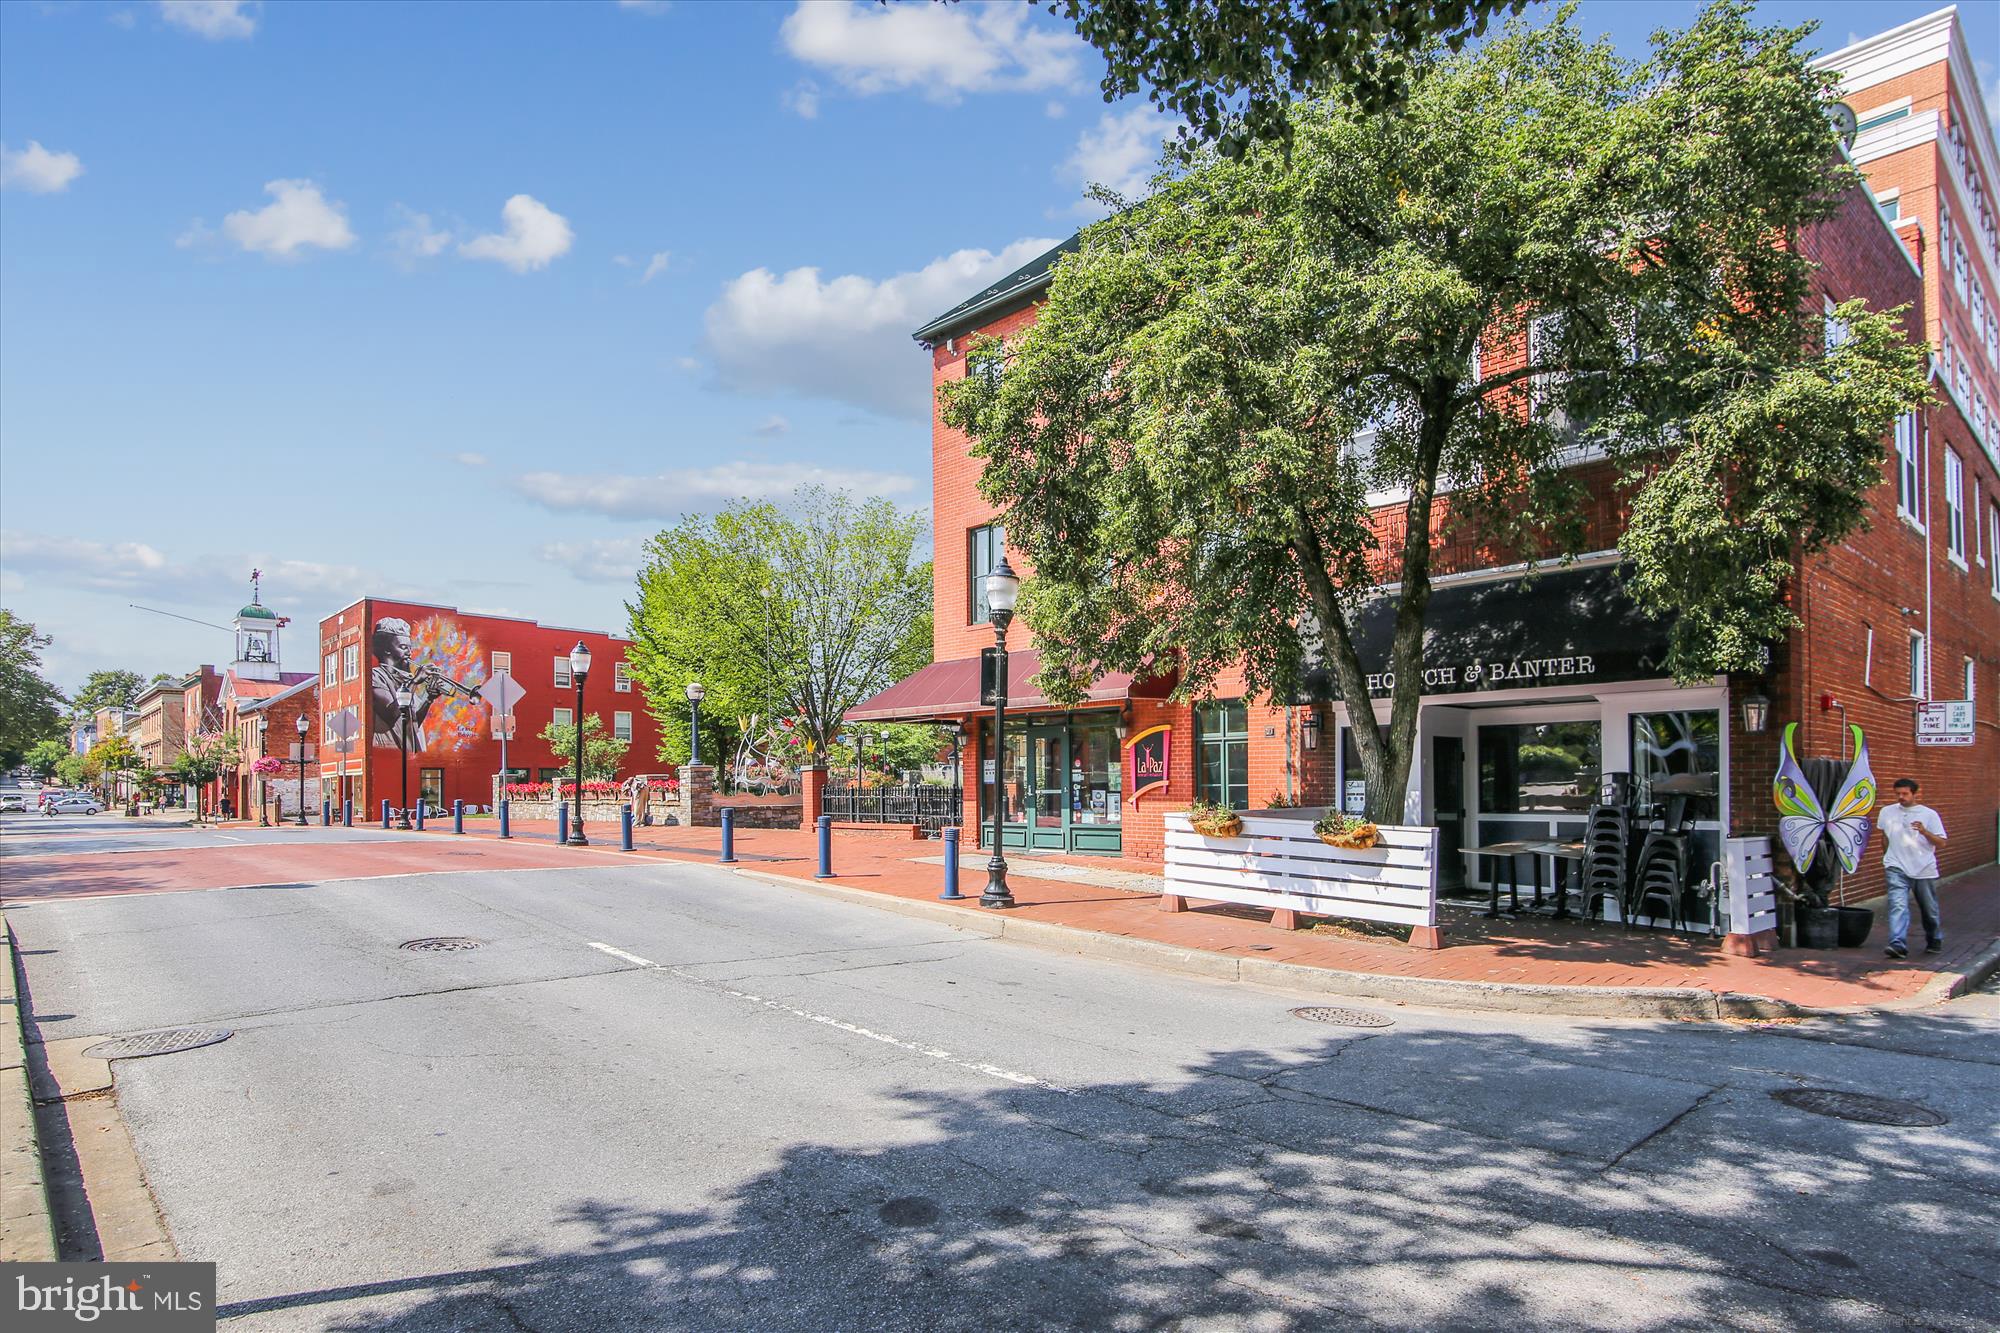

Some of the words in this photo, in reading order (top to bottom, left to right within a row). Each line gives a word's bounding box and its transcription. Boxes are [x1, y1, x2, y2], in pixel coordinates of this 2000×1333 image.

[1464, 665, 1482, 682] &
[1489, 655, 1595, 681] BANTER
[1137, 757, 1146, 773] La
[1149, 757, 1163, 773] Paz
